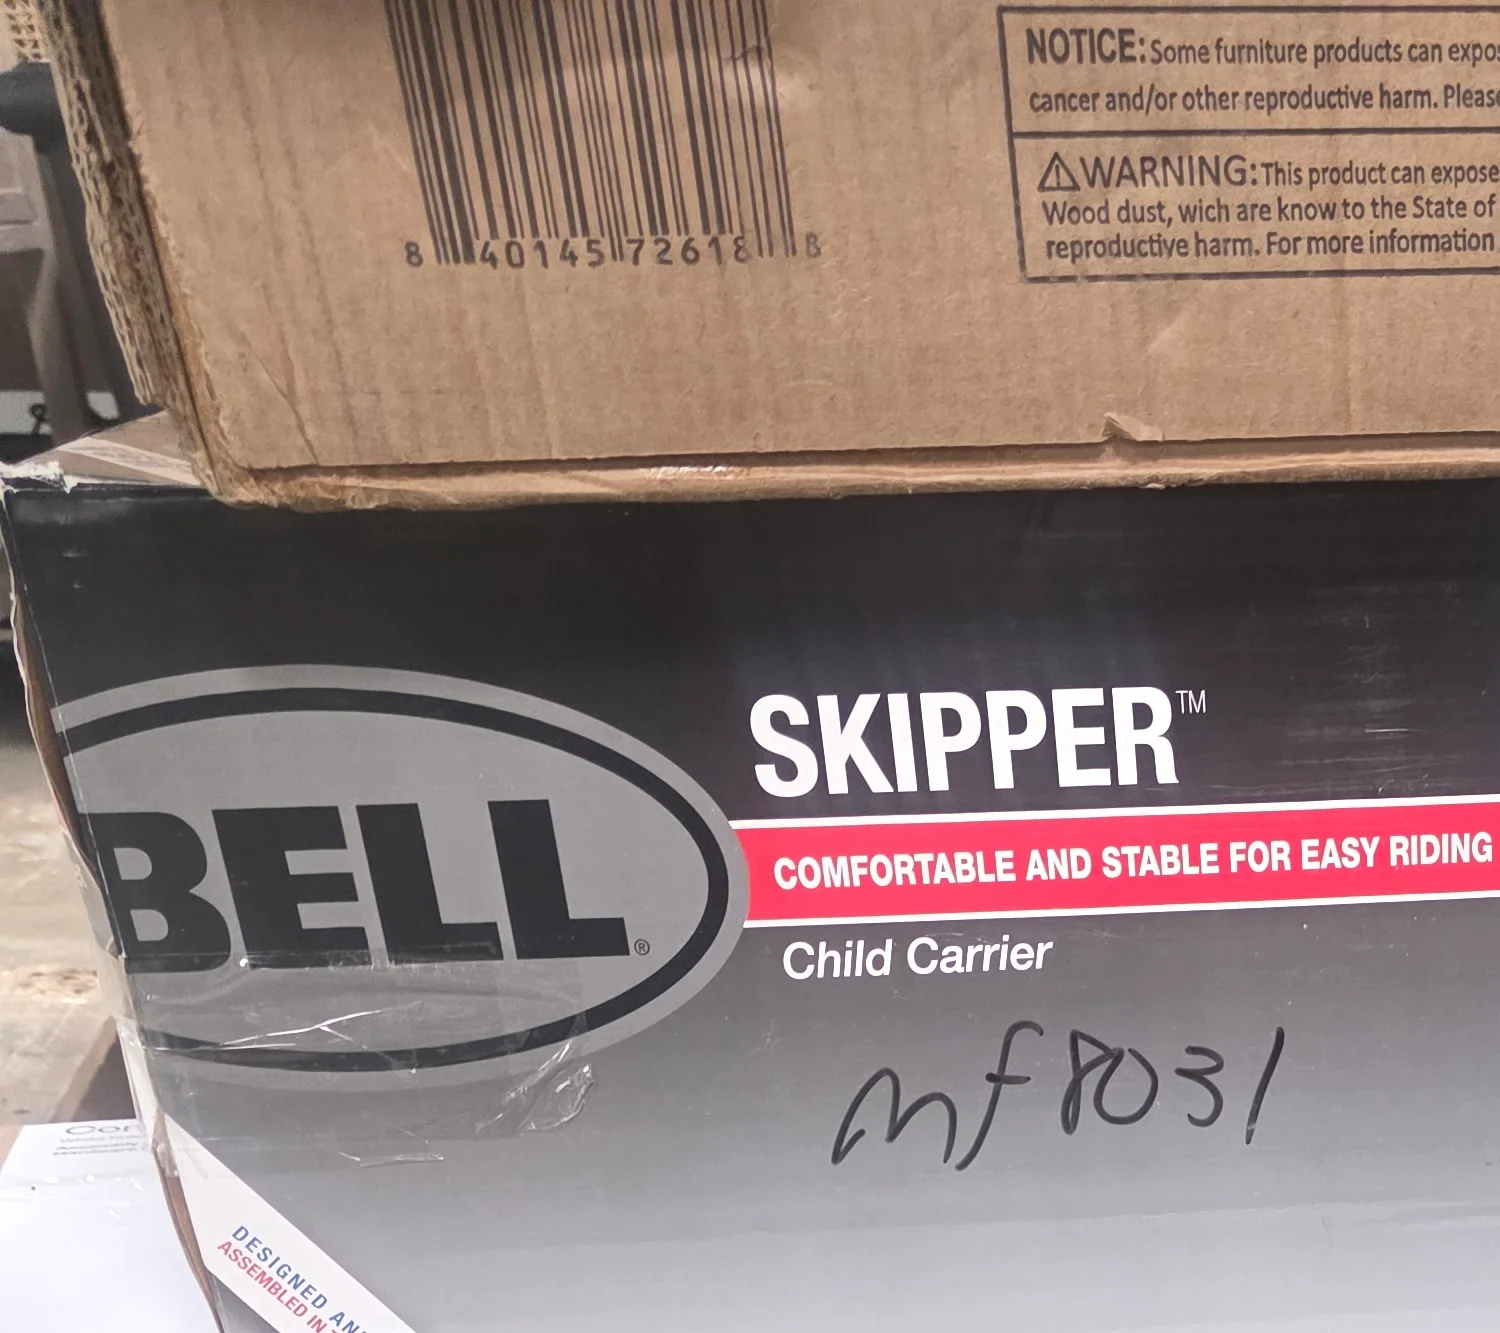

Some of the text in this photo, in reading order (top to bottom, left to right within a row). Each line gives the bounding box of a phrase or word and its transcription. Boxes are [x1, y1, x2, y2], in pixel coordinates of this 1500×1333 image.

[1025, 28, 1146, 64] NOTICE:
[1150, 39, 1211, 65] Some
[1214, 37, 1308, 64] furniture
[1313, 36, 1403, 69] products
[1407, 43, 1443, 63] can
[1029, 91, 1101, 113] cancer
[1105, 82, 1178, 116] and/or
[1181, 83, 1240, 111] other
[1244, 83, 1374, 117] reproductive
[1378, 81, 1438, 110] harm.
[1079, 154, 1258, 189] WARNING:
[1260, 160, 1303, 187] This
[1308, 159, 1387, 192] product
[1390, 165, 1426, 185] can
[1430, 164, 1500, 189] expose
[1041, 198, 1111, 226] Wood
[1117, 198, 1173, 228] dust,
[1177, 197, 1230, 224] wich
[1236, 203, 1272, 223] are
[1276, 195, 1337, 222] know
[1341, 198, 1365, 220] to
[1370, 194, 1407, 220] the
[1412, 195, 1468, 219] State
[1473, 192, 1497, 218] of
[1046, 232, 1189, 264] reproductive
[1194, 230, 1261, 258] harm.
[1266, 231, 1303, 256] For
[1306, 234, 1364, 255] more
[1369, 227, 1495, 254] information
[750, 686, 1180, 797] SKIPPER
[773, 831, 1494, 891] COMFORTABLE AND STABLE FOR EASY RIDING
[80, 799, 630, 974] BELL
[782, 935, 1053, 981] Child Carrier
[216, 1240, 308, 1319] ASSEMBLED
[306, 1314, 328, 1333] IN
[231, 1225, 328, 1310] DESIGNED
